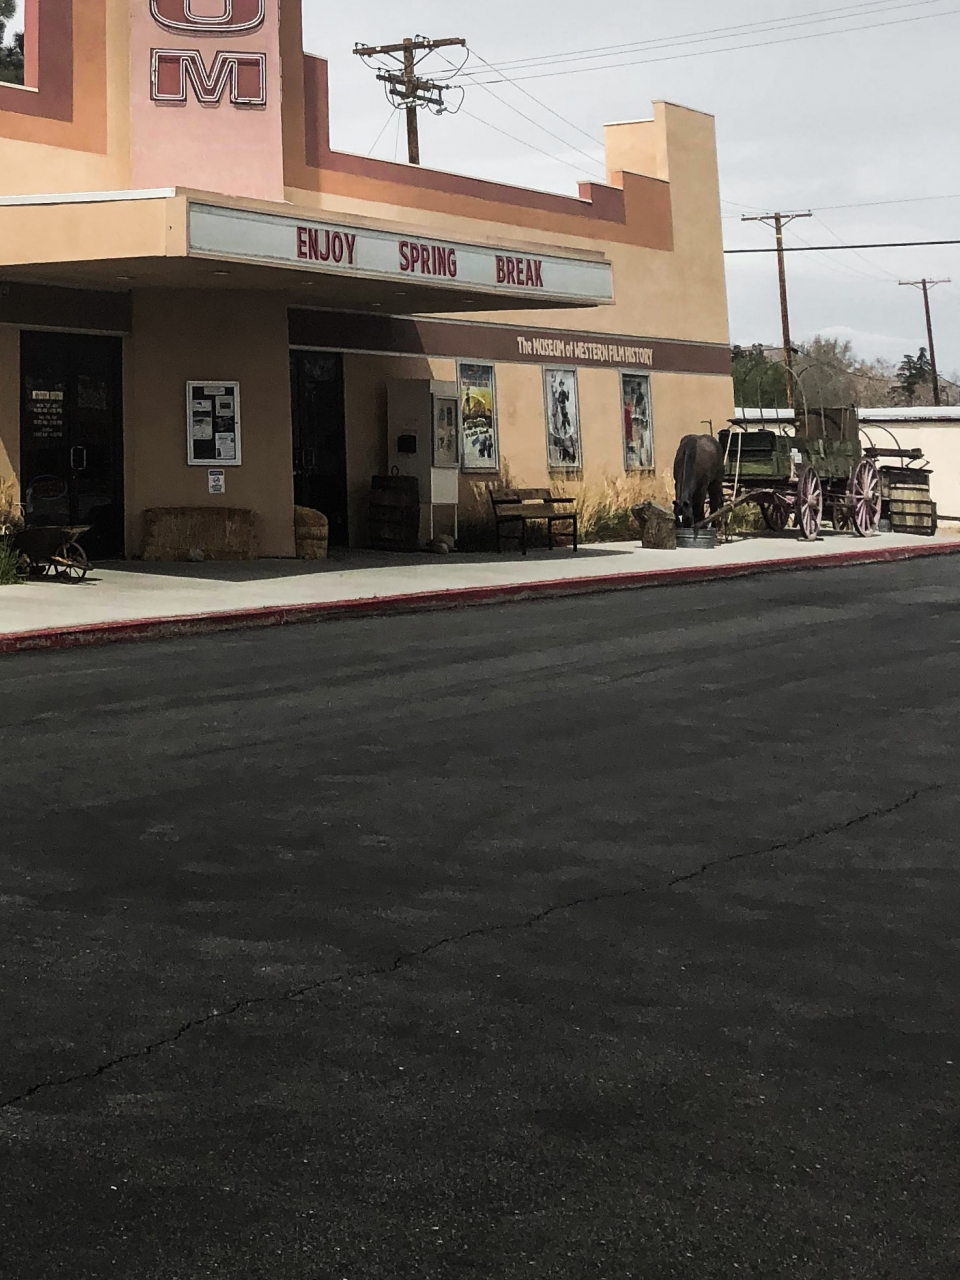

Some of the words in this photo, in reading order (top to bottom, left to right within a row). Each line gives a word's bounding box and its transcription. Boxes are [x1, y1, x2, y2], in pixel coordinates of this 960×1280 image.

[297, 226, 356, 265] ENJOY
[398, 240, 457, 278] SPRING
[495, 255, 544, 287] BREAK
[517, 336, 532, 355] The
[532, 337, 565, 357] MUSEUM
[565, 342, 574, 358] of
[573, 342, 608, 362] WESTERN
[608, 344, 625, 363] FILM
[625, 346, 653, 366] HISTORY
